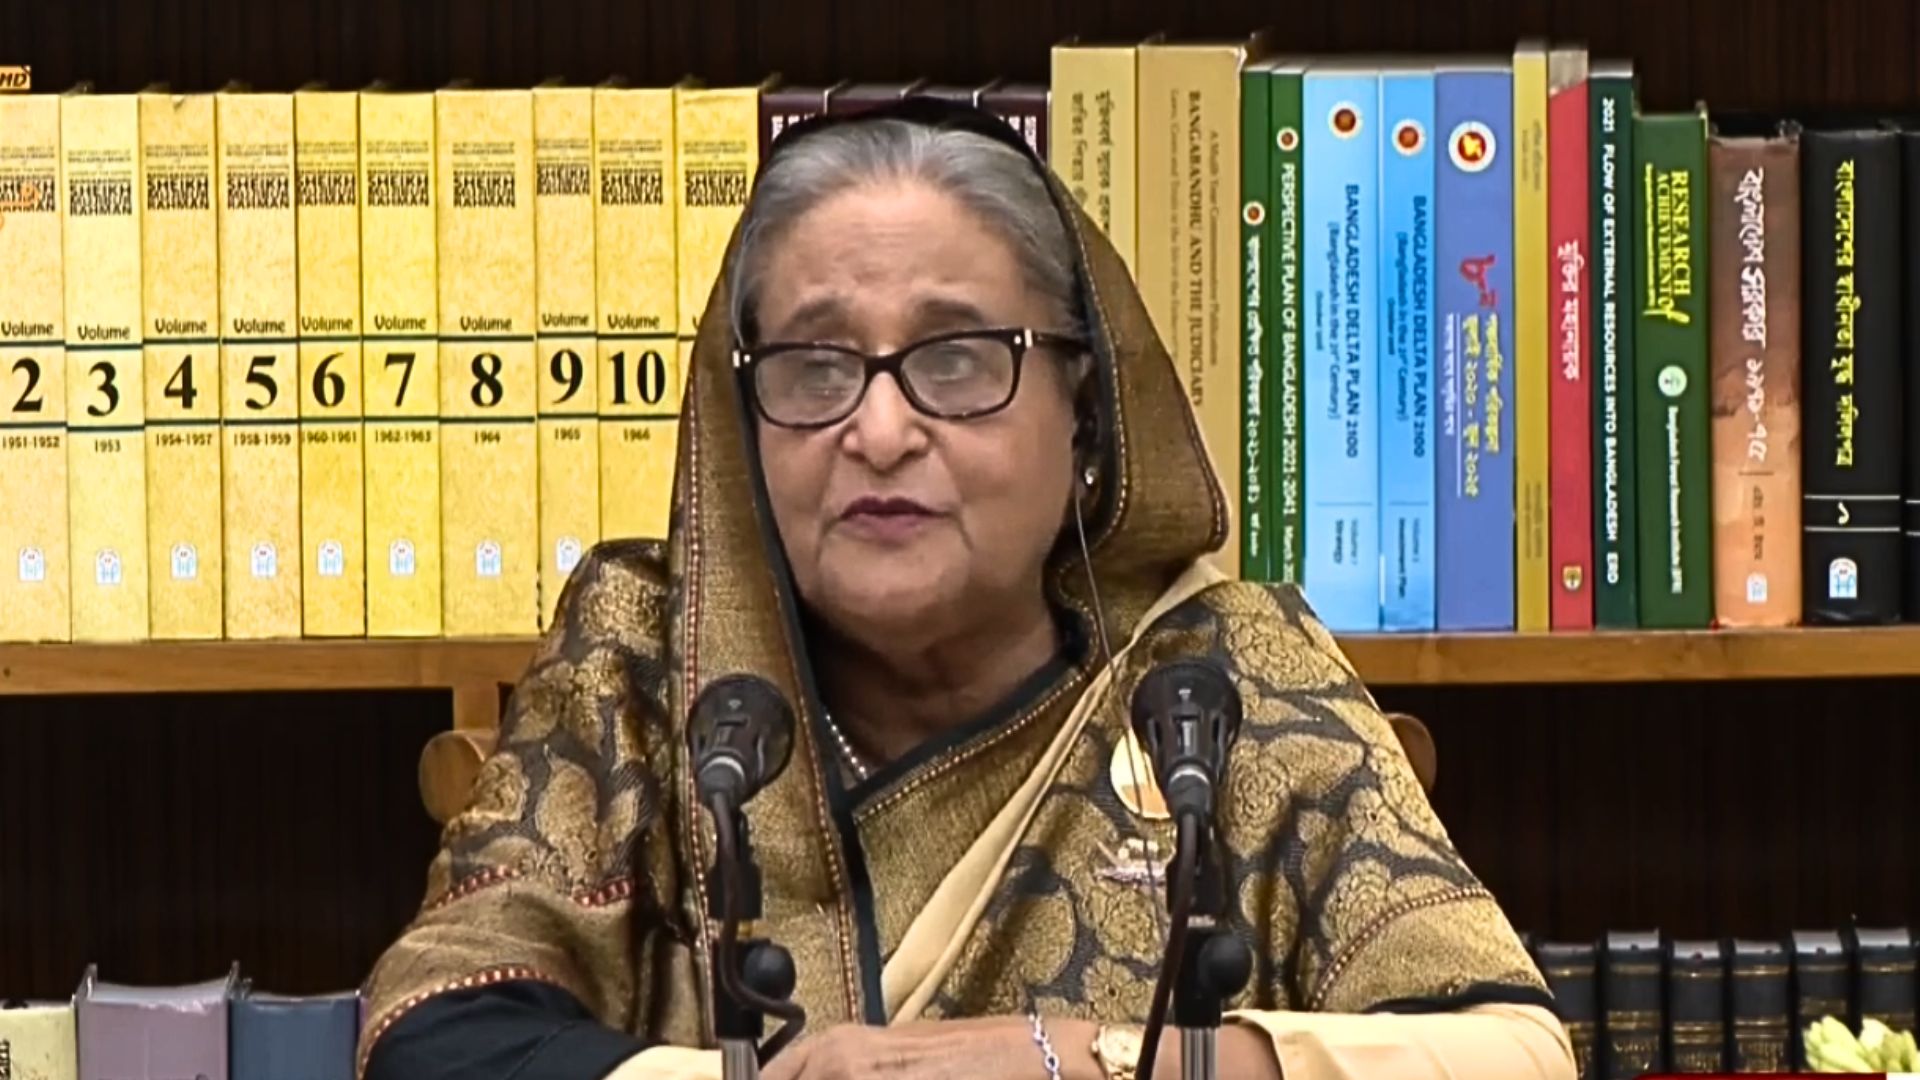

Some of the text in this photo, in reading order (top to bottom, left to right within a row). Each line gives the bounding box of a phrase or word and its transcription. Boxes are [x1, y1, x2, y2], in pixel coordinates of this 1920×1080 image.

[1189, 91, 1202, 229] BANGABANDHU
[1281, 163, 1295, 261] PERSPECTIVE
[1643, 172, 1690, 324] ACHIEVEMENT of
[1671, 170, 1691, 296] RESEARCH
[1189, 236, 1203, 275] AND
[1190, 278, 1204, 311] THE
[1281, 264, 1296, 304] PLAN
[155, 318, 207, 334] Volume
[234, 318, 286, 334] Volume
[302, 317, 353, 332] Volume
[375, 315, 427, 331] Volume
[460, 316, 512, 332] Volume
[542, 313, 589, 328] Volume
[607, 314, 660, 330] Volume
[1282, 307, 1296, 329] OF
[1330, 303, 1339, 316] in
[1345, 184, 1360, 458] BANGLADESH DELTA PLAN 2100
[1399, 310, 1408, 322] in
[1413, 195, 1427, 458] BANGLADESH DELTA PLAN 2100
[1557, 240, 1585, 380] মুক্তির মহানায়ক
[1734, 167, 1767, 462] বাংলাদেশ সরকার ১৯৭১-৭৫
[1831, 159, 1862, 466] বাংলাদেশের স্বাধীনতা যুদ্ধ দলিলপত্র
[1, 321, 54, 336] Volume
[78, 325, 130, 341] Volume
[1330, 318, 1339, 340] the
[1398, 324, 1408, 344] the
[1603, 97, 1619, 584] 2021 FLOW OF EXTERNAL RESOURCES INTO BANGLADESH ERD
[12, 358, 43, 412] 2
[87, 361, 119, 416] 3
[164, 354, 197, 409] 4
[245, 355, 278, 410] 5
[313, 352, 345, 408] 6
[384, 352, 416, 408] 7
[471, 352, 503, 408] 8
[550, 348, 583, 404] 9
[609, 349, 666, 405] 10
[1282, 332, 1297, 435] BANGLADESH
[1327, 364, 1341, 420] Century)
[2, 436, 60, 449] 1951-1952
[94, 439, 121, 453] 1953
[155, 433, 213, 447] 1954-1957
[234, 433, 291, 446] 1958-1959
[302, 431, 357, 445] 1960-1961
[375, 430, 432, 444] 1962-1963
[474, 431, 501, 444] 1964
[554, 428, 581, 441] 1965
[623, 428, 650, 442] 1966
[1283, 438, 1297, 515] 2021-2041
[1284, 526, 1294, 560] March
[1333, 519, 1344, 564] Strategy
